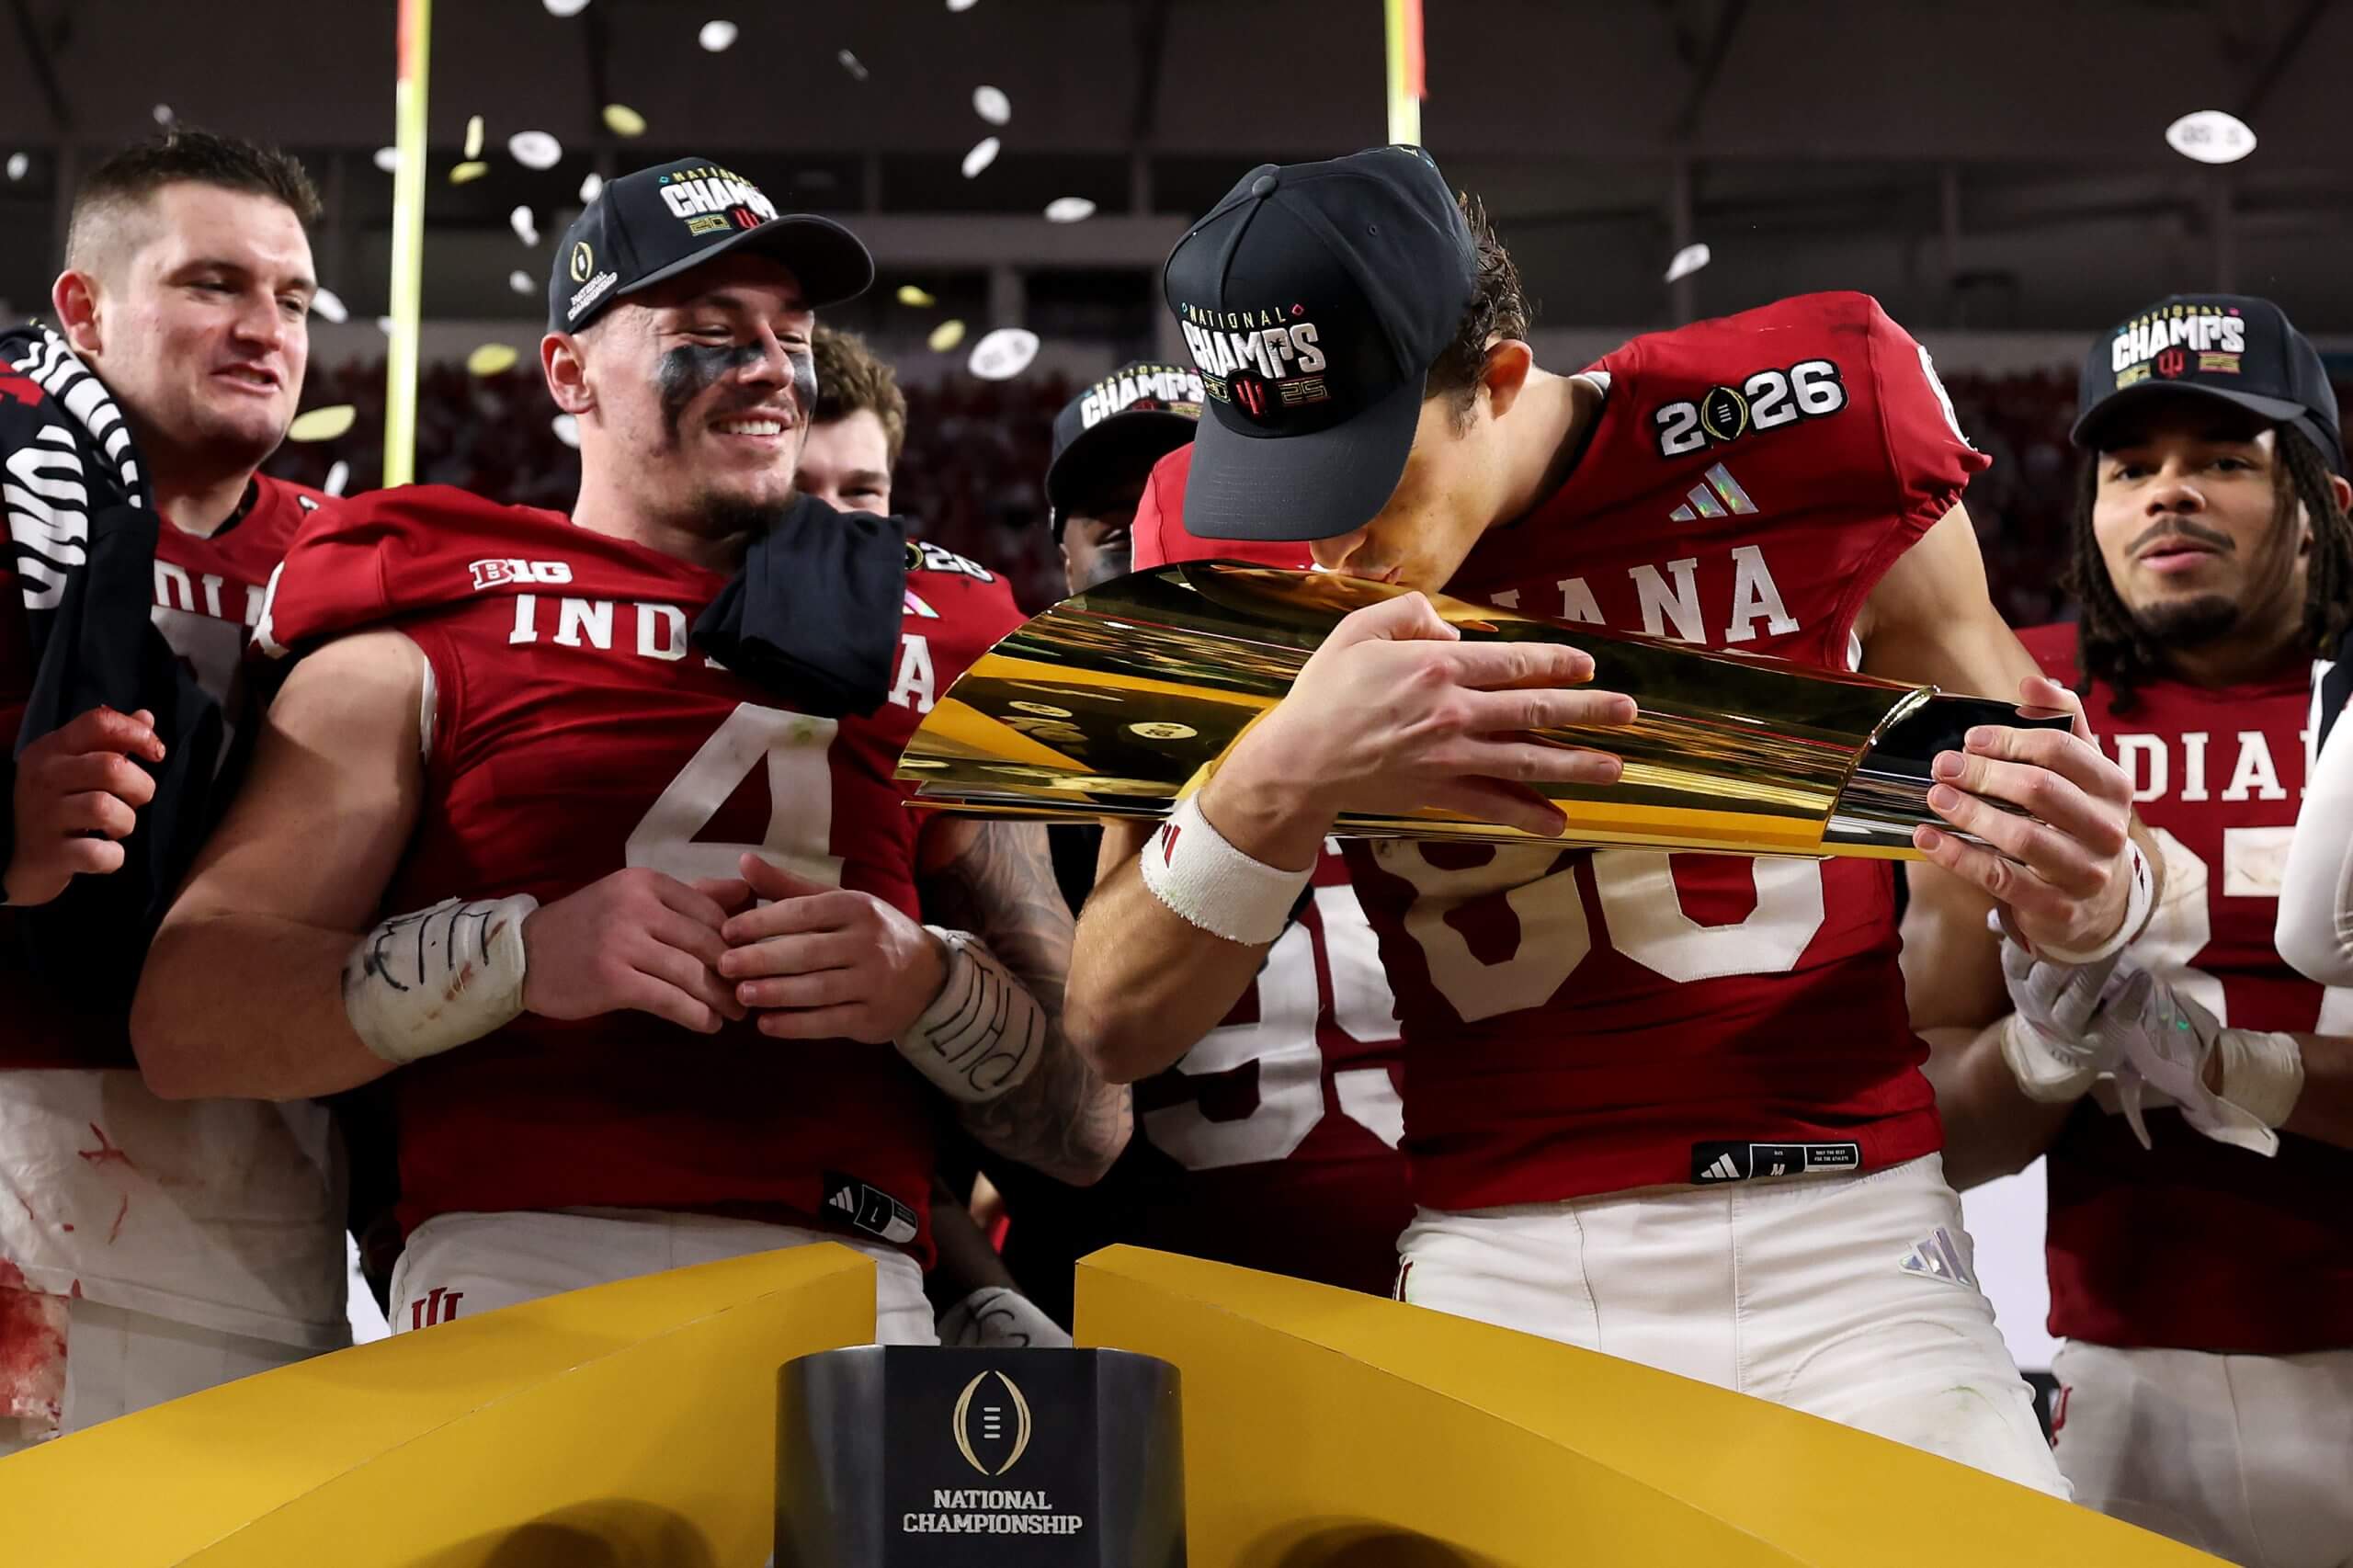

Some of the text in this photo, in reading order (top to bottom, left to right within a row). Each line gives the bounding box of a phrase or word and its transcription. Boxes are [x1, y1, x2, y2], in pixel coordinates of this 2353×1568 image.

[1189, 304, 1286, 329] NATIONAL
[1182, 320, 1326, 379] CHAMPS
[2112, 315, 2245, 372] CHAMPS
[1081, 372, 1205, 429] CHAMPS
[1279, 378, 1328, 404] 25
[625, 701, 846, 892] 4
[1770, 1163, 1786, 1176] M
[934, 1489, 1052, 1510] NATIONAL
[903, 1513, 1083, 1534] CHAMPIONSHIP
